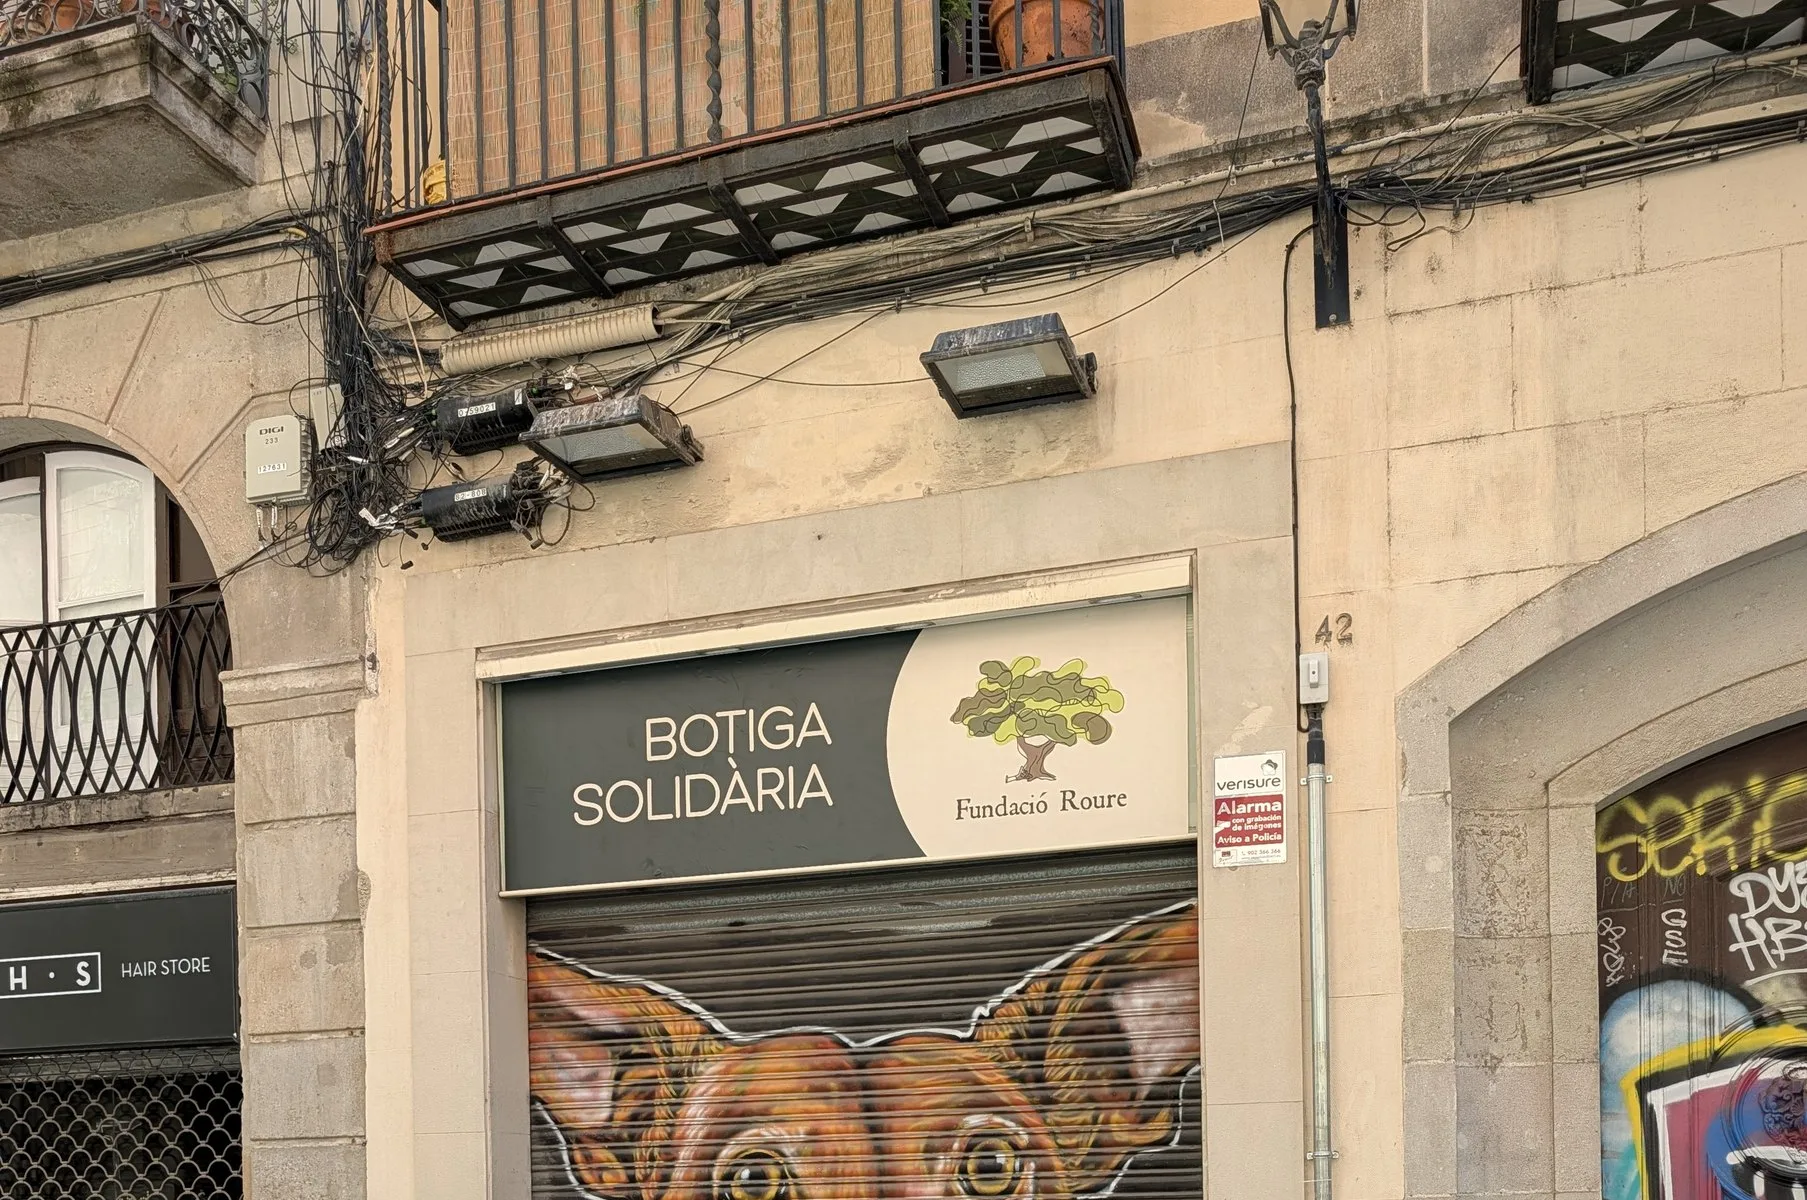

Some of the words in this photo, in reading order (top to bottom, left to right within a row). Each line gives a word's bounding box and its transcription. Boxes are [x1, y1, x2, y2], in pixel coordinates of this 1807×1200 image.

[259, 426, 285, 436] DIGI
[1315, 613, 1352, 646] 42
[646, 702, 832, 762] BOTIGA
[573, 756, 834, 826] SOLIDÀRIA
[1216, 777, 1281, 791] verisure
[955, 791, 1048, 821] Fundació
[1060, 789, 1128, 812] Roure
[1216, 800, 1282, 815] Alarma
[1246, 814, 1281, 824] grabación
[1217, 836, 1242, 844] Aviso
[1252, 832, 1282, 842] Policía
[9, 965, 27, 991] H
[75, 960, 91, 987] S
[121, 961, 157, 978] HAIR
[161, 957, 211, 976] STORE
